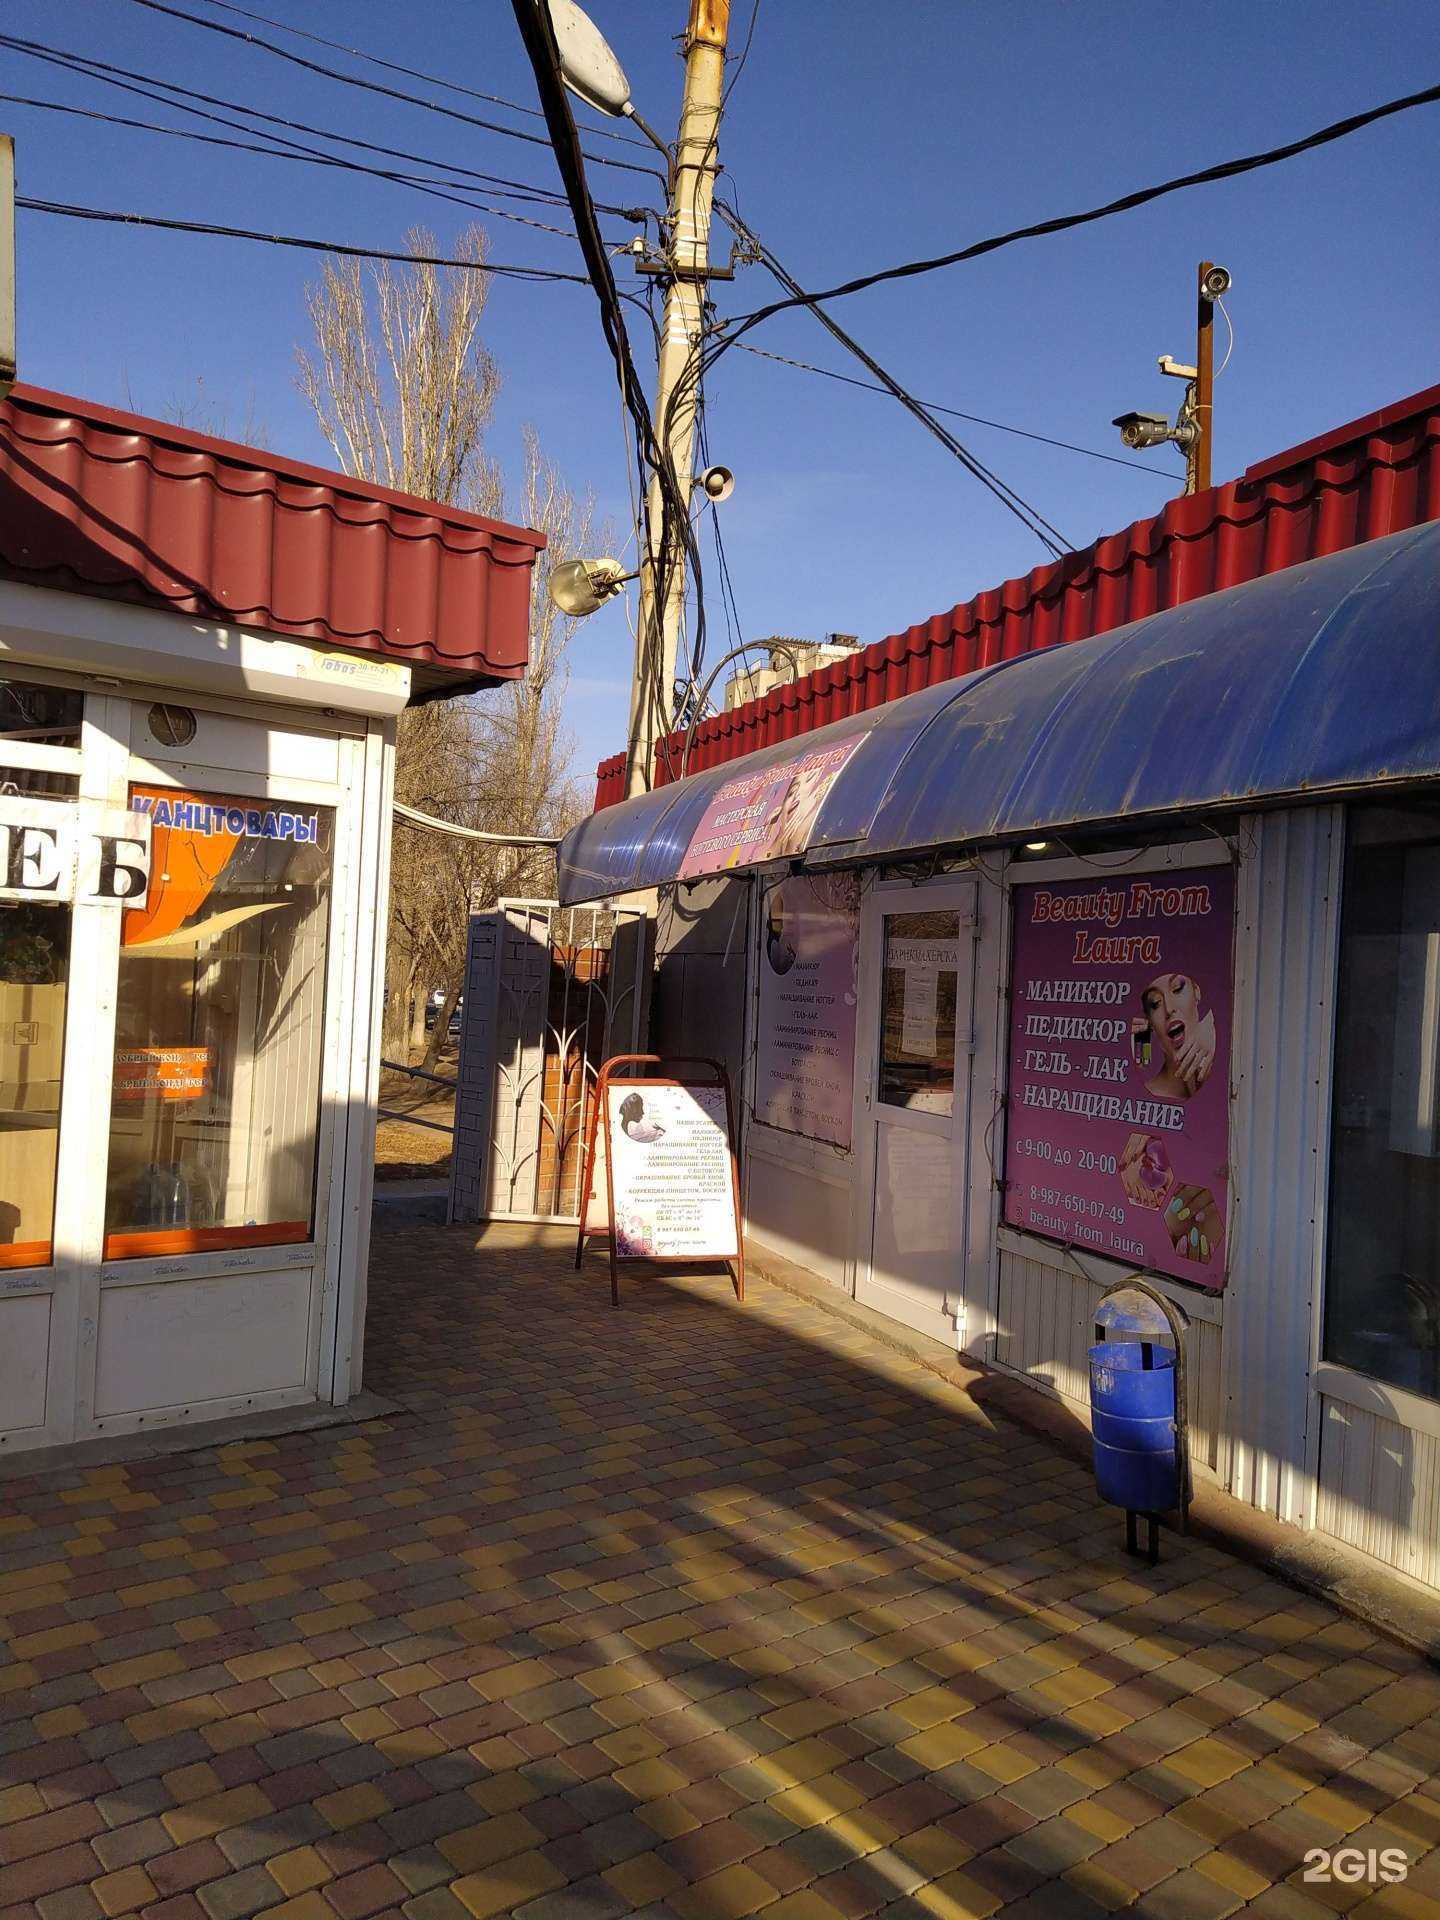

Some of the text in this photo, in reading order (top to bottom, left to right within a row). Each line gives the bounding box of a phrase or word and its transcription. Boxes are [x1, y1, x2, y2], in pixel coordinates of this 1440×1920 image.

[131, 795, 318, 844] КАНЦТОВАРЫ
[1031, 883, 1212, 928] Beauty From
[1073, 930, 1161, 965] Laura
[1025, 980, 1132, 1005] МАНИКЮР
[1024, 1015, 1127, 1044] ПЕДИКЮР
[1023, 1049, 1072, 1076] ГЕЛЬ
[1083, 1055, 1129, 1083] ЛАК
[1022, 1084, 1185, 1131] НАРАЩИВАНИЕ
[1025, 1138, 1052, 1160] 9-00
[1053, 1149, 1072, 1166] до
[1078, 1149, 1117, 1175] 20-00
[1030, 1184, 1126, 1225] 8-987-650-07-49
